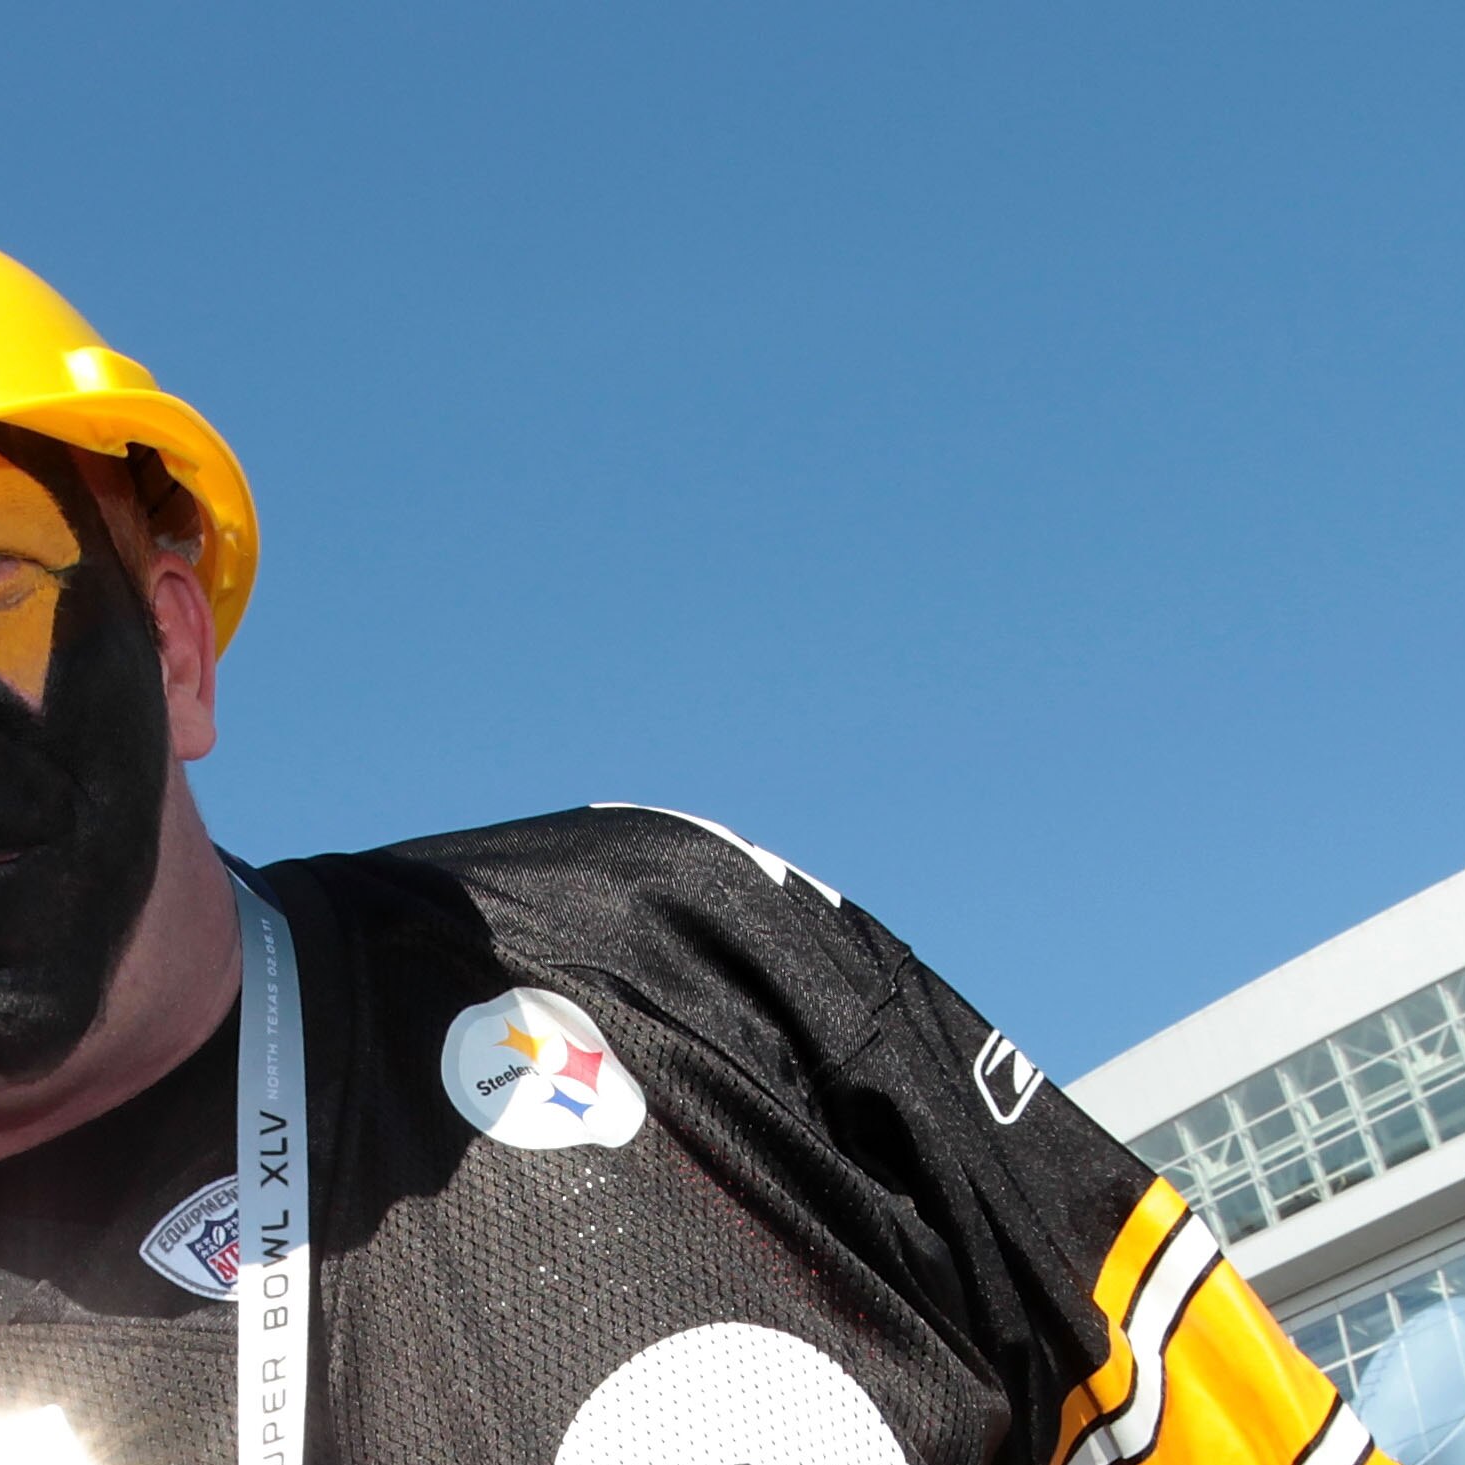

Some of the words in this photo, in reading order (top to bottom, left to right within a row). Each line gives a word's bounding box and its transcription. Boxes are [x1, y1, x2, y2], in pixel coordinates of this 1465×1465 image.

[261, 918, 278, 976] 02.06.11
[266, 984, 279, 1036] TEXAS
[267, 1043, 280, 1100] NORTH
[259, 1110, 289, 1188] XLV
[156, 1185, 238, 1254] EQUIPMEN
[261, 1209, 290, 1331] BOWL
